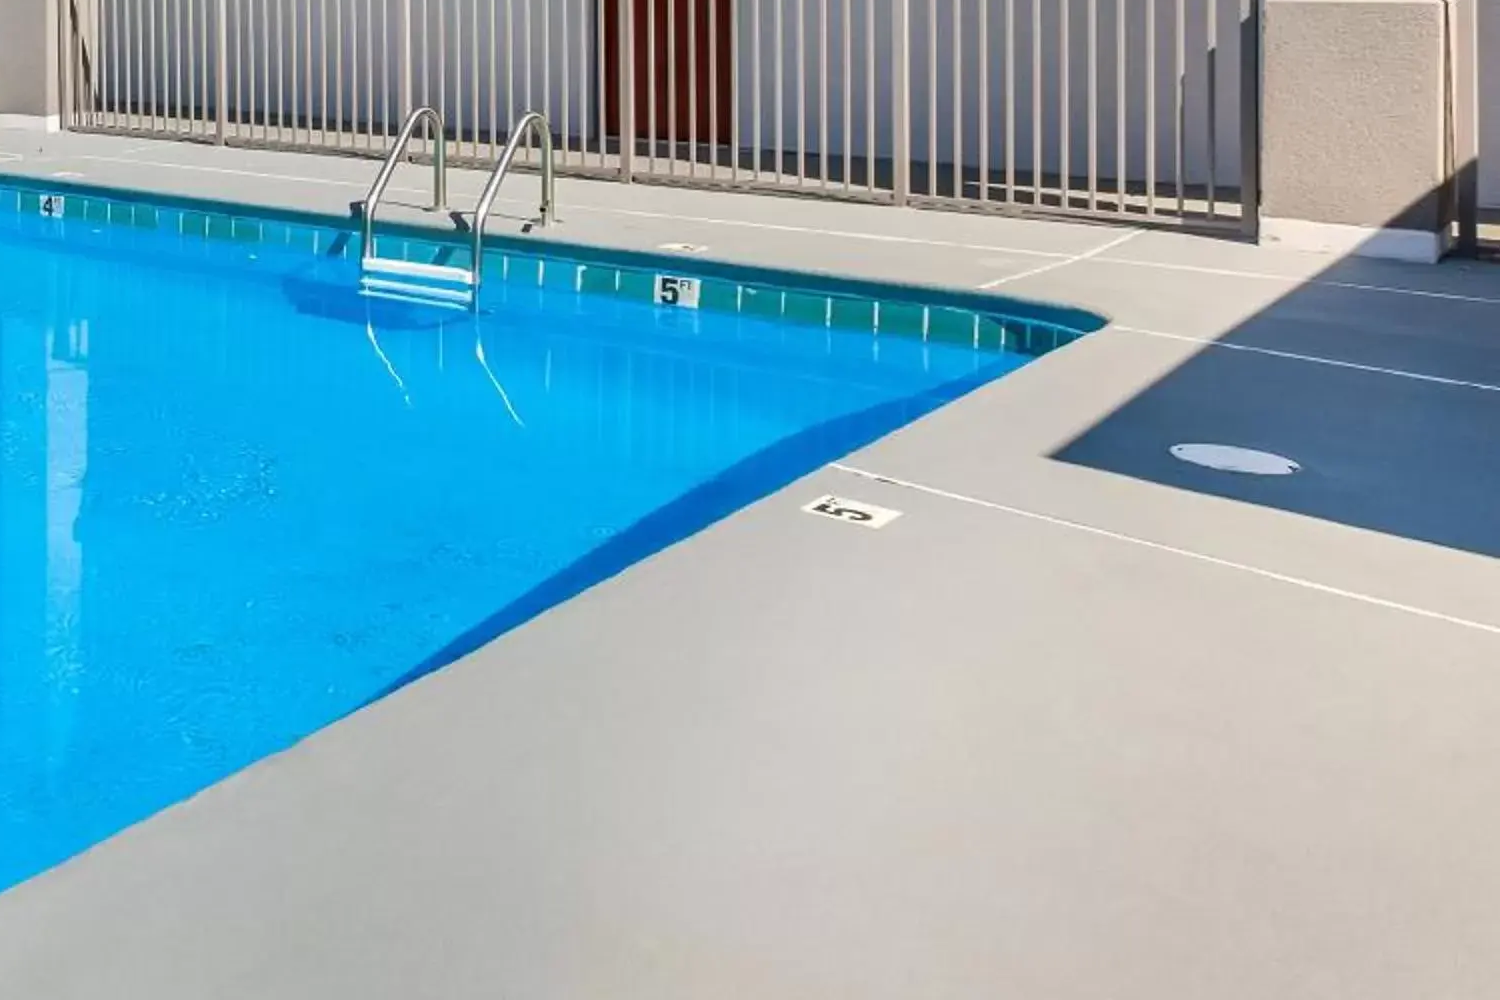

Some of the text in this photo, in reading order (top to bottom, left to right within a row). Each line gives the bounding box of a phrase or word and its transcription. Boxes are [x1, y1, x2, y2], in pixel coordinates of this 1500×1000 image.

[43, 196, 54, 217] 4
[661, 277, 679, 305] 5
[811, 503, 873, 521] 5
